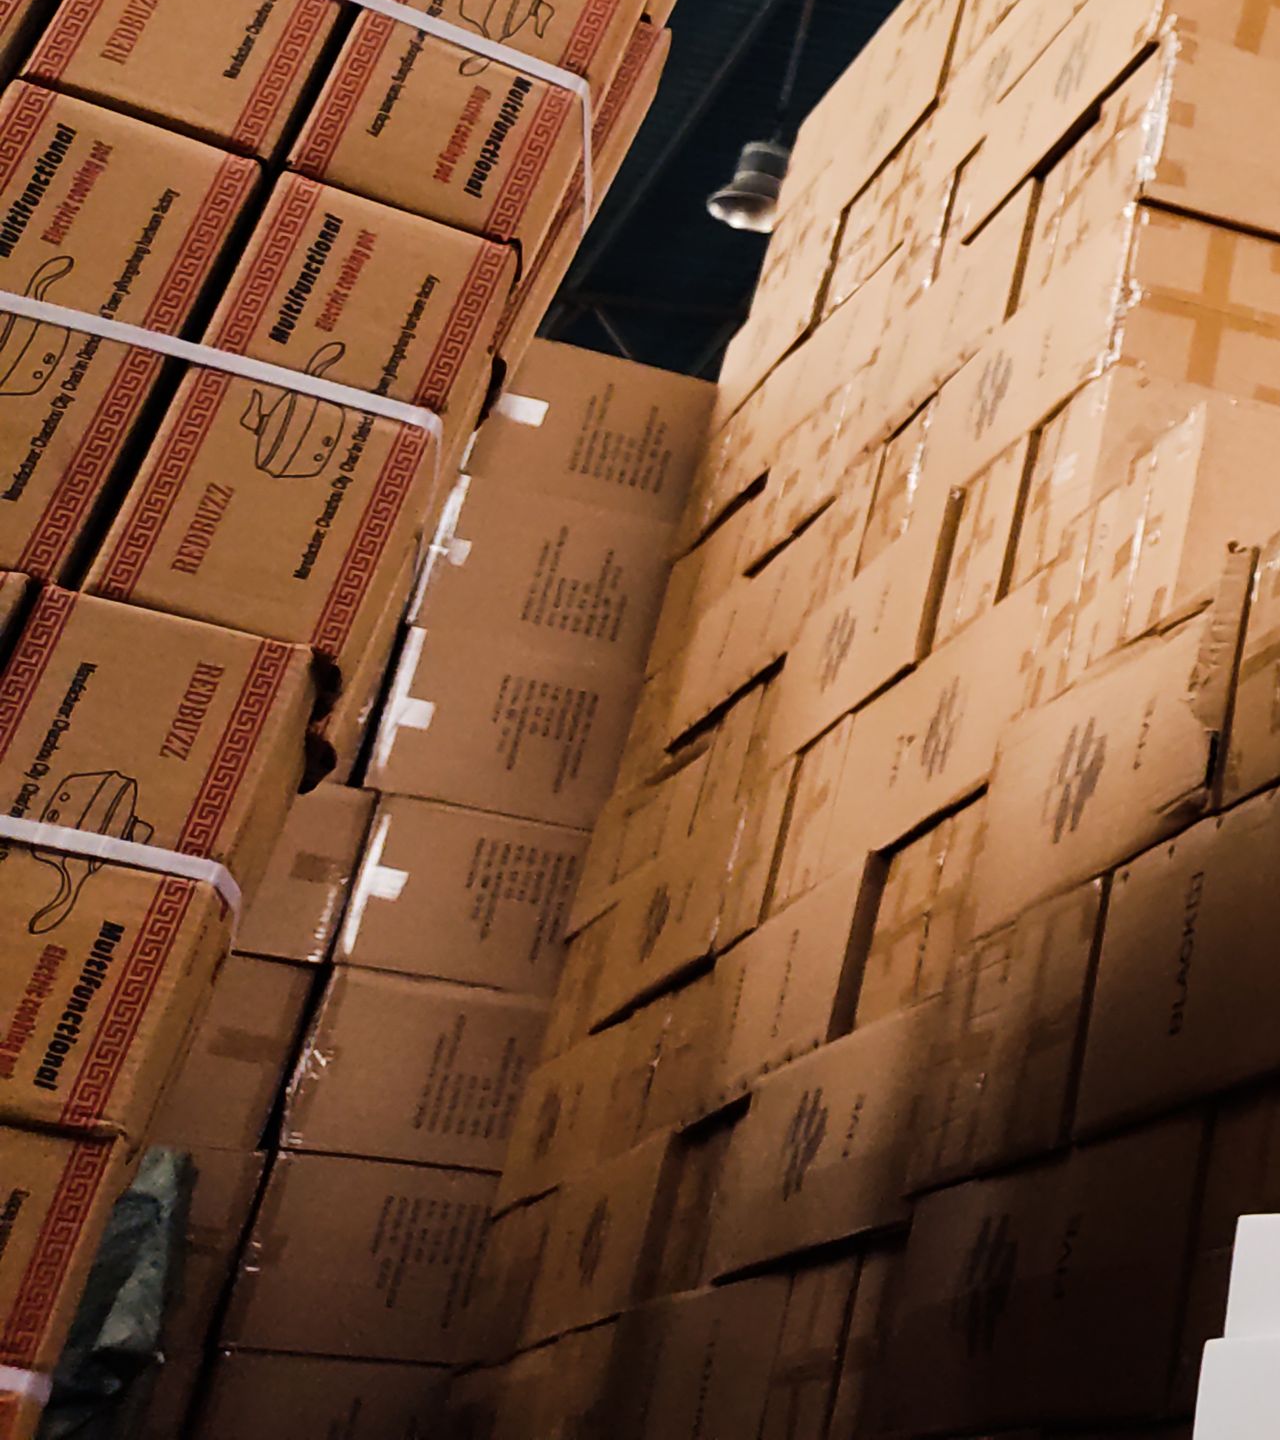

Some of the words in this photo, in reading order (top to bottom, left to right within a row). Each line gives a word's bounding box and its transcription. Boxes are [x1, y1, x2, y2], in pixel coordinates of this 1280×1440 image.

[0, 123, 77, 258] Multifunctional
[463, 77, 532, 199] Multifunctional
[40, 201, 80, 246] Electric
[66, 160, 104, 204] cooking
[90, 140, 113, 164] pot
[269, 213, 343, 344] Multifunctional
[314, 289, 349, 332] Electric
[336, 249, 370, 290] cooking
[356, 229, 376, 251] pot
[170, 483, 234, 575] REDBUZZ
[159, 662, 225, 761] REDBUZZ
[24, 763, 50, 780] City
[33, 921, 125, 1091] Multifunctional
